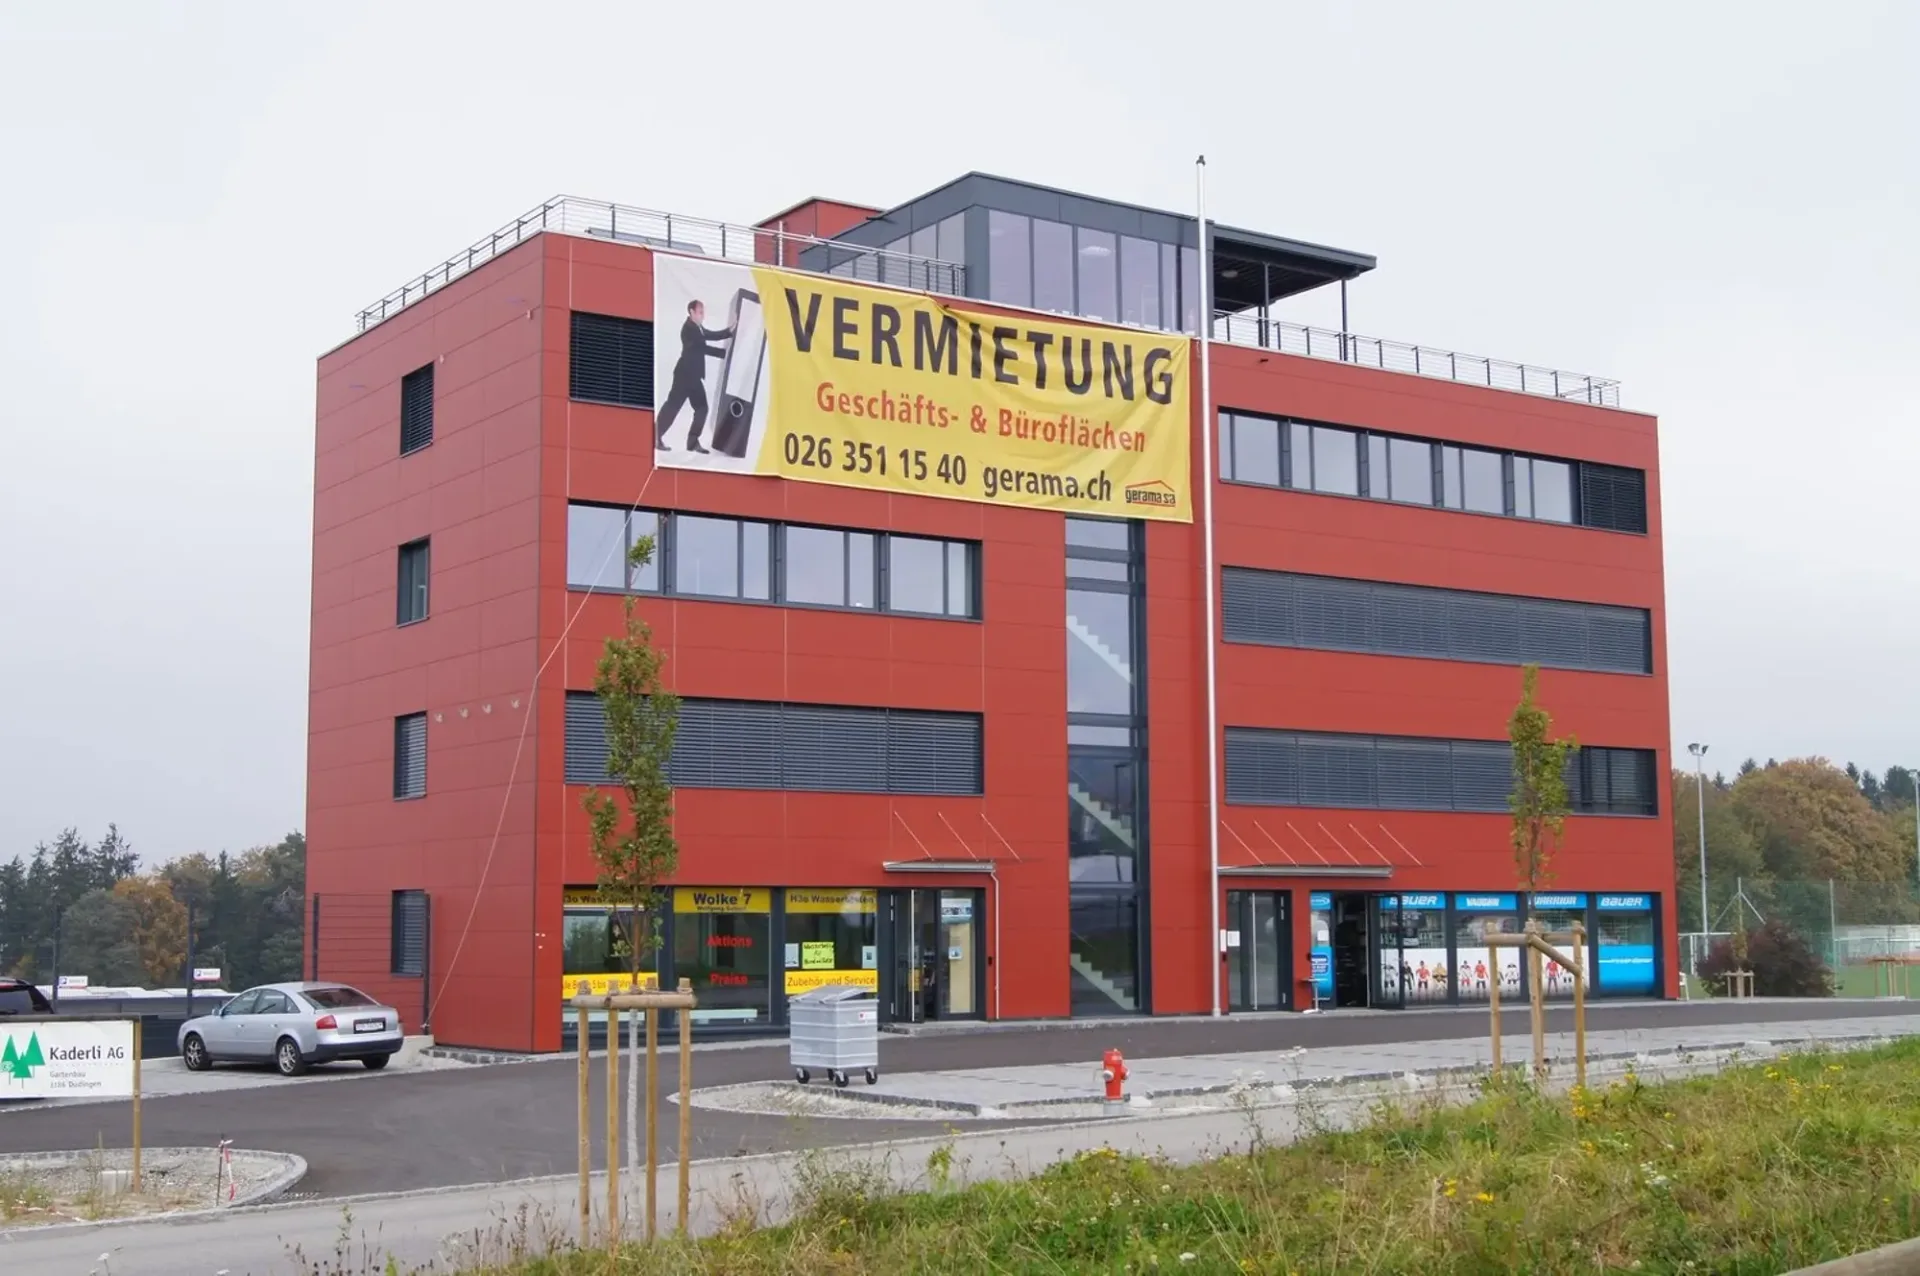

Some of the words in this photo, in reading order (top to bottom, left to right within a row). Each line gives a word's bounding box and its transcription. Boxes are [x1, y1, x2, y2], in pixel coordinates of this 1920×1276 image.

[784, 287, 1174, 405] VERMIETUNG
[816, 381, 960, 429] Geschäfts-
[970, 405, 988, 433] &
[999, 408, 1145, 453] Büroflächen
[784, 432, 833, 469] 026
[842, 440, 888, 477] 351
[899, 447, 929, 481] 15
[937, 455, 967, 486] 40
[983, 463, 1112, 502] gerama.ch
[1125, 489, 1162, 503] gerama
[693, 892, 738, 906] Wolke
[743, 893, 752, 905] 7
[787, 976, 824, 987] Zubehör
[826, 976, 842, 986] und
[844, 975, 875, 986] Service
[50, 1045, 101, 1060] Kaderli
[107, 1046, 124, 1059] AG
